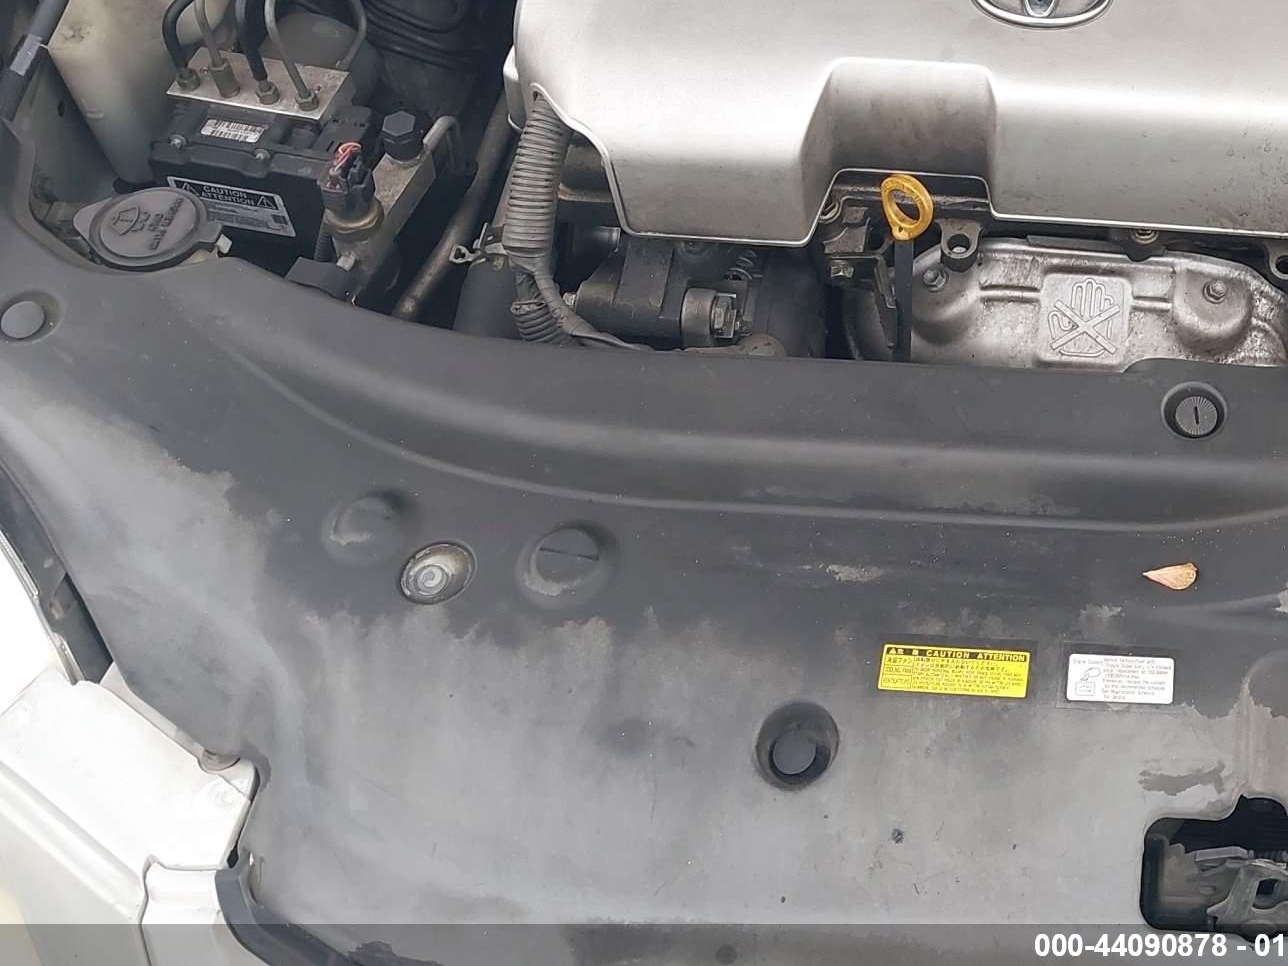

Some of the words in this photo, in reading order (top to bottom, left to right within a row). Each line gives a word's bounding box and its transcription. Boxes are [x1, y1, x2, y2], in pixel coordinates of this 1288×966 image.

[201, 192, 255, 206] ATTENTION
[203, 185, 248, 199] CAUTION
[926, 649, 970, 659] CAUTION
[976, 652, 1026, 662] ATTENTION
